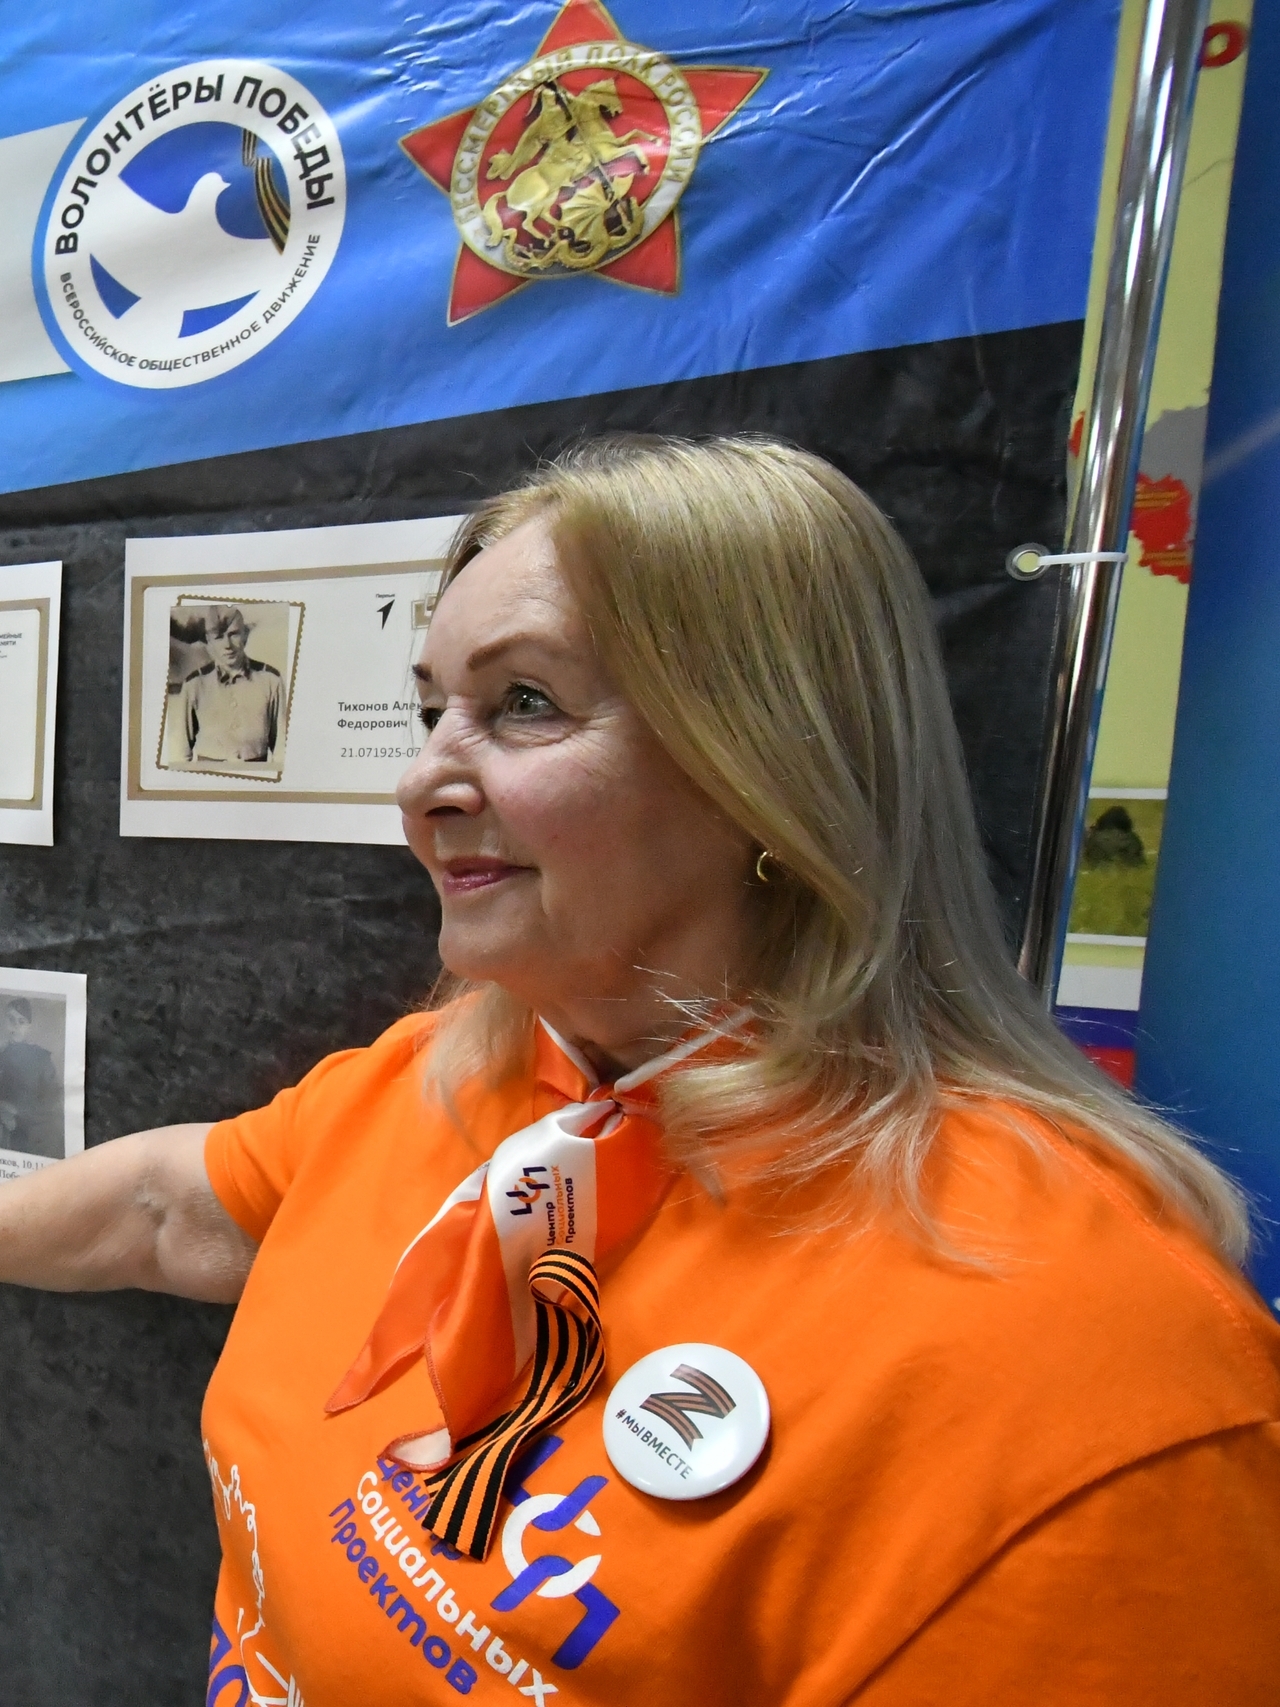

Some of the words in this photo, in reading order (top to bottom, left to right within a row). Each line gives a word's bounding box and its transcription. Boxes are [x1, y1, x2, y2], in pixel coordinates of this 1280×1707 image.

[54, 74, 224, 255] ВОЛОНТЁРЫ
[233, 75, 335, 211] ПОБЕДЫ
[655, 71, 697, 183] РОССИИ
[60, 272, 137, 368] ВСЕРОССИЙСКОЕ
[138, 322, 262, 372] ОБЩЕСТВЕННОЕ
[262, 234, 321, 324] ДВИЖЕНИЕ
[337, 718, 408, 731] Федорович
[338, 702, 389, 712] Тихонов
[546, 1201, 556, 1247] Центр
[551, 1165, 565, 1246] Социальных
[565, 1177, 576, 1244] Проектов
[615, 1408, 694, 1480] #МЫВМЕСТЕ
[329, 1498, 479, 1695] Проектов
[356, 1470, 559, 1707] Социальных
